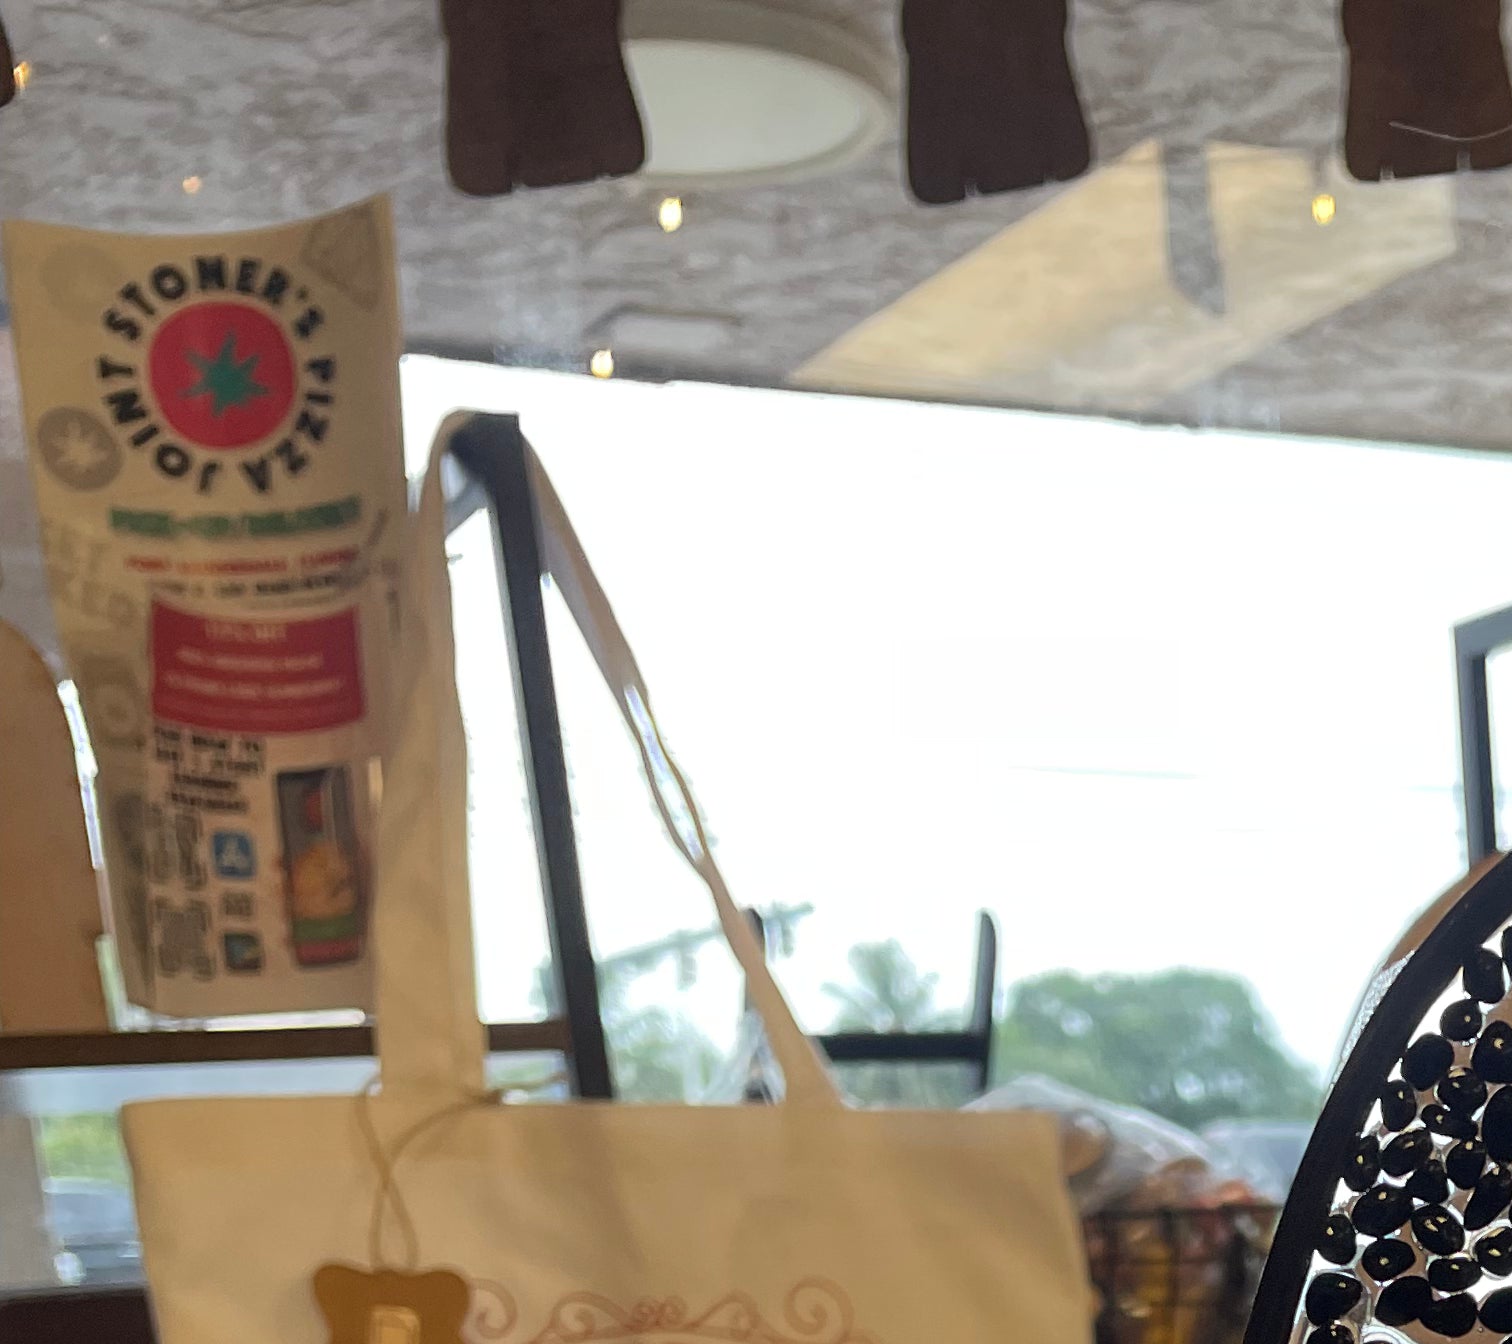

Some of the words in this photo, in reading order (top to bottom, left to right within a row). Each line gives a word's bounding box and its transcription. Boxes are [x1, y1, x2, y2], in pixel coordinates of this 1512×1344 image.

[103, 254, 324, 343] STONER'S
[96, 355, 222, 495] JOINT
[240, 353, 336, 493] PIZZA
